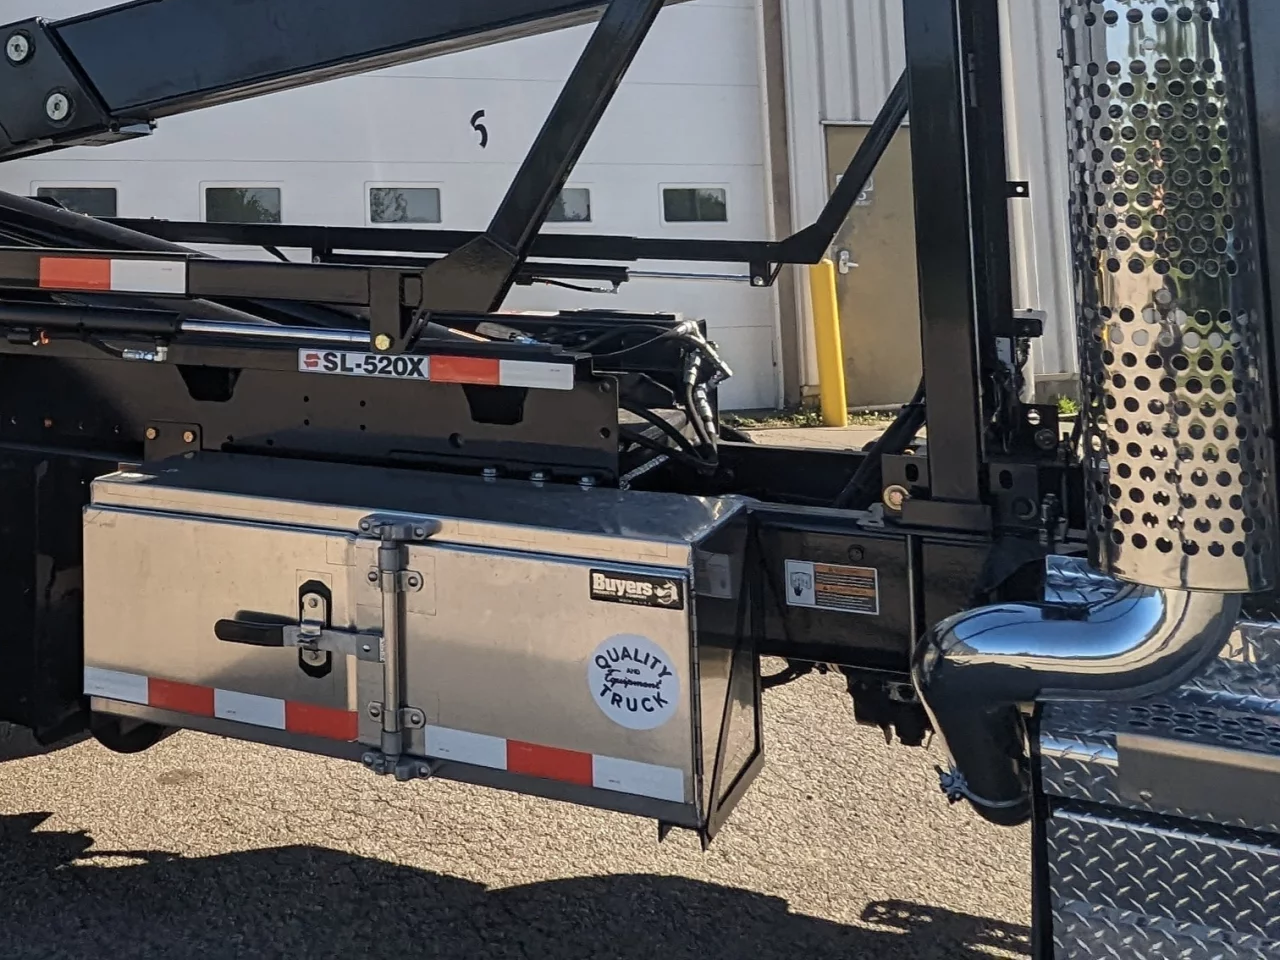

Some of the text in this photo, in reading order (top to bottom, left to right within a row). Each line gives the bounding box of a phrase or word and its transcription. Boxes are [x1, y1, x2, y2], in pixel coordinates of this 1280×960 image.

[323, 351, 425, 378] SL-520X
[592, 572, 653, 596] Buyers
[595, 646, 673, 678] QUALITY
[604, 669, 662, 689] Equipment
[600, 683, 669, 713] TRUCK
